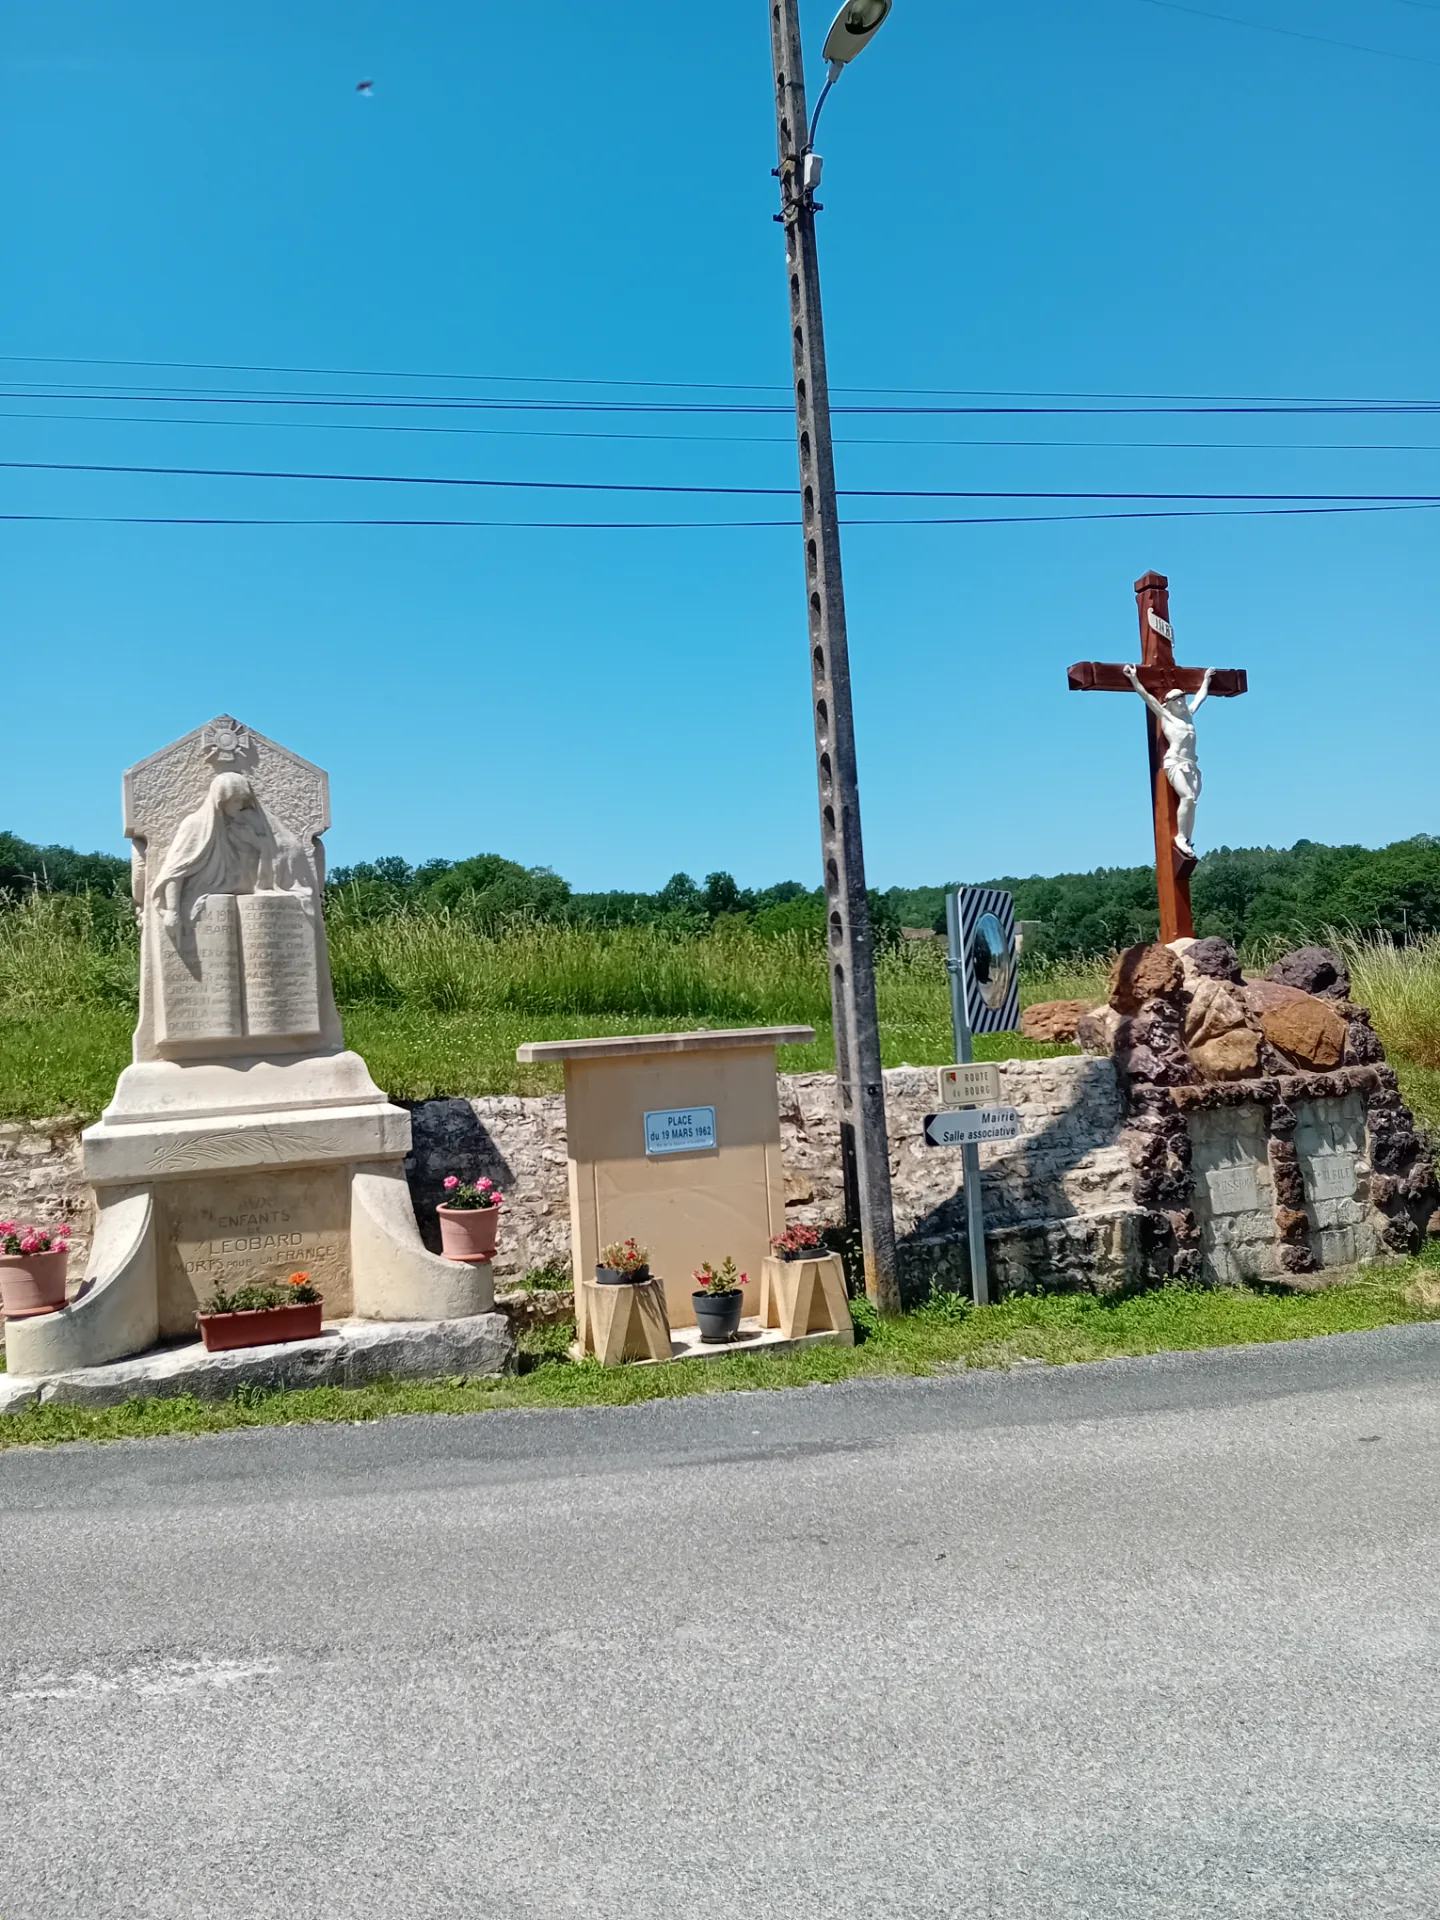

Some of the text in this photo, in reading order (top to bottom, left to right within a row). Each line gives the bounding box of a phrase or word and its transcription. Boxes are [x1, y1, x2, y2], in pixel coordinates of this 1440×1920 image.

[964, 1071, 988, 1082] ROUTE
[964, 1085, 990, 1096] BOURG
[668, 1115, 692, 1127] PLACE
[981, 1111, 1015, 1124] Mairie
[650, 1126, 712, 1141] du 19 MARS 1962
[943, 1126, 1016, 1142] Salle associative
[238, 1196, 272, 1210] AUX
[218, 1211, 290, 1228] ENFANTS
[209, 1232, 302, 1255] LEOBARD
[174, 1258, 224, 1273] MORTS
[227, 1258, 252, 1268] POUR
[276, 1245, 336, 1262] FRANCE
